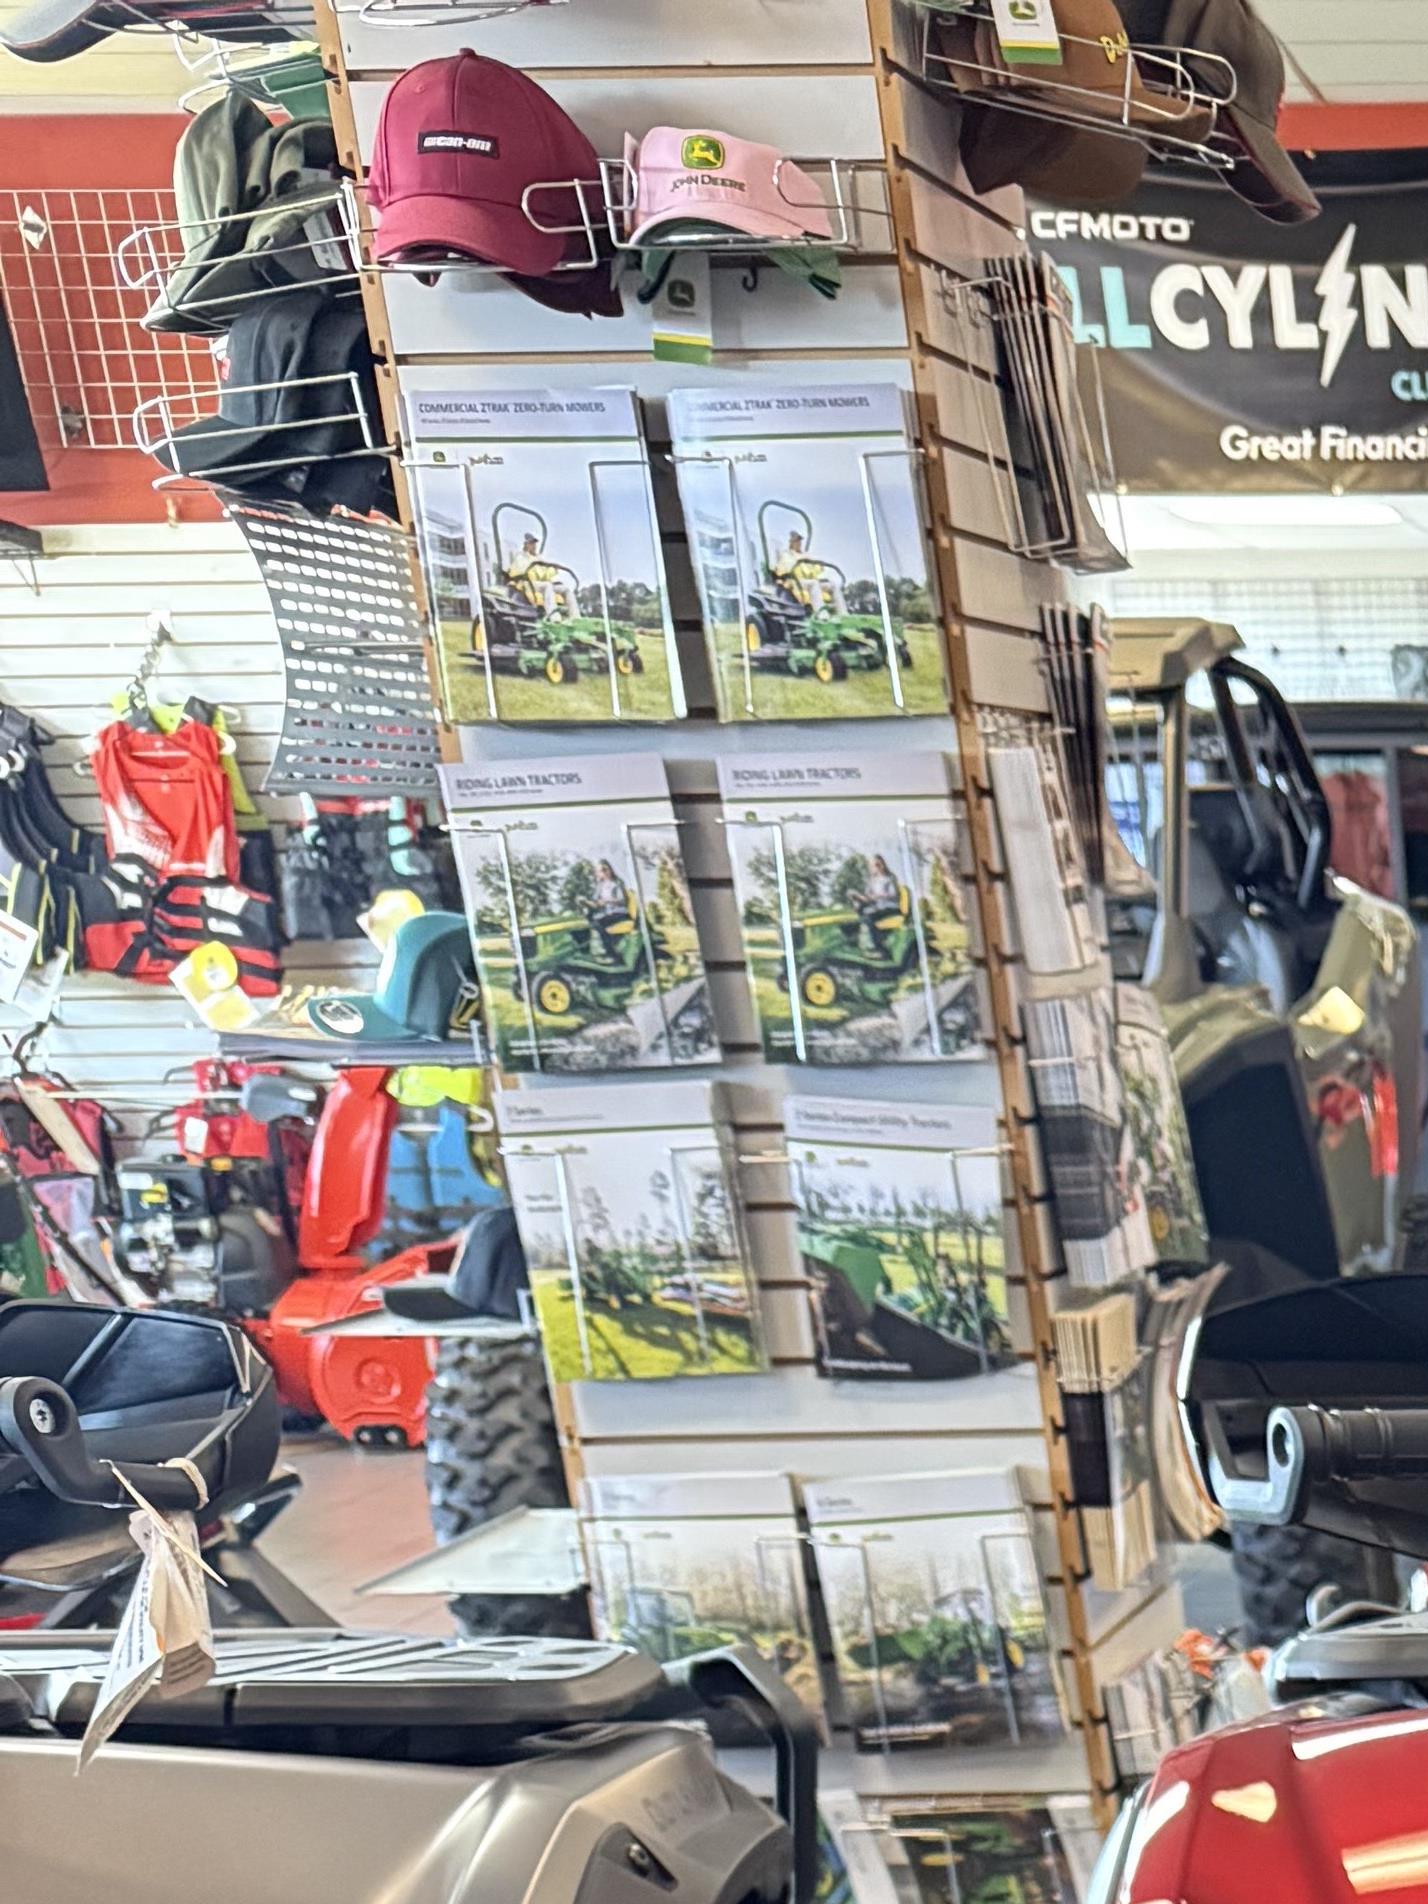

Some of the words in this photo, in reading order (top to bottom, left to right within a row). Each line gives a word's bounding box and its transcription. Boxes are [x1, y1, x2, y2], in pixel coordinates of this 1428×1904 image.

[670, 174, 699, 193] JOHN
[700, 173, 747, 194] DEERE
[1030, 211, 1191, 241] CFMOTO
[418, 402, 479, 414] COMMERCIAL
[512, 402, 564, 413] ZERO-TURN
[565, 402, 606, 413] MOWERS
[1220, 424, 1316, 461] Great
[456, 777, 494, 790] RIDING
[494, 775, 527, 788] LAWN
[527, 772, 583, 787] TRACTORS
[806, 767, 862, 780] TRACTORS
